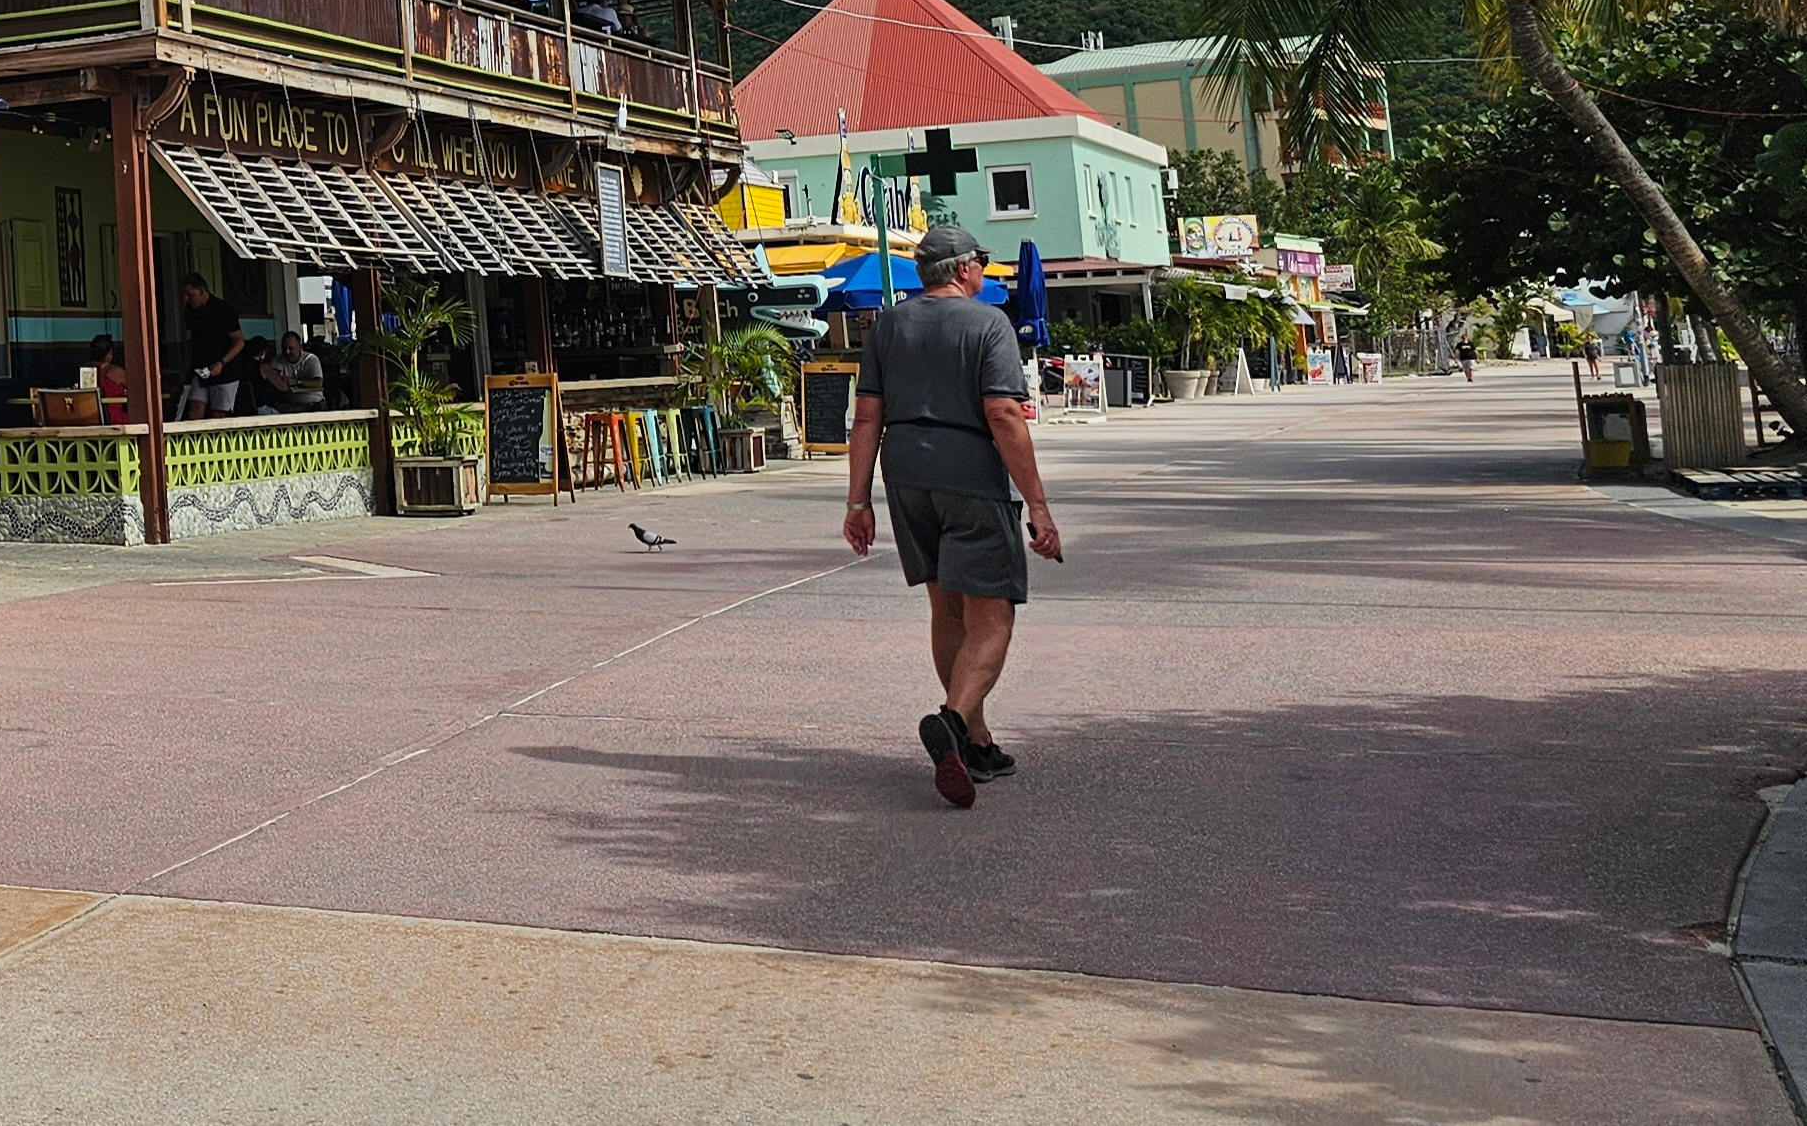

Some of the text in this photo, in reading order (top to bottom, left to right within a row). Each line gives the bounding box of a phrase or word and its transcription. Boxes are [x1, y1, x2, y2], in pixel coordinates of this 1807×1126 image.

[179, 91, 197, 136] A
[203, 93, 248, 143] FUN
[256, 101, 318, 152] PLACE
[322, 110, 349, 155] TO
